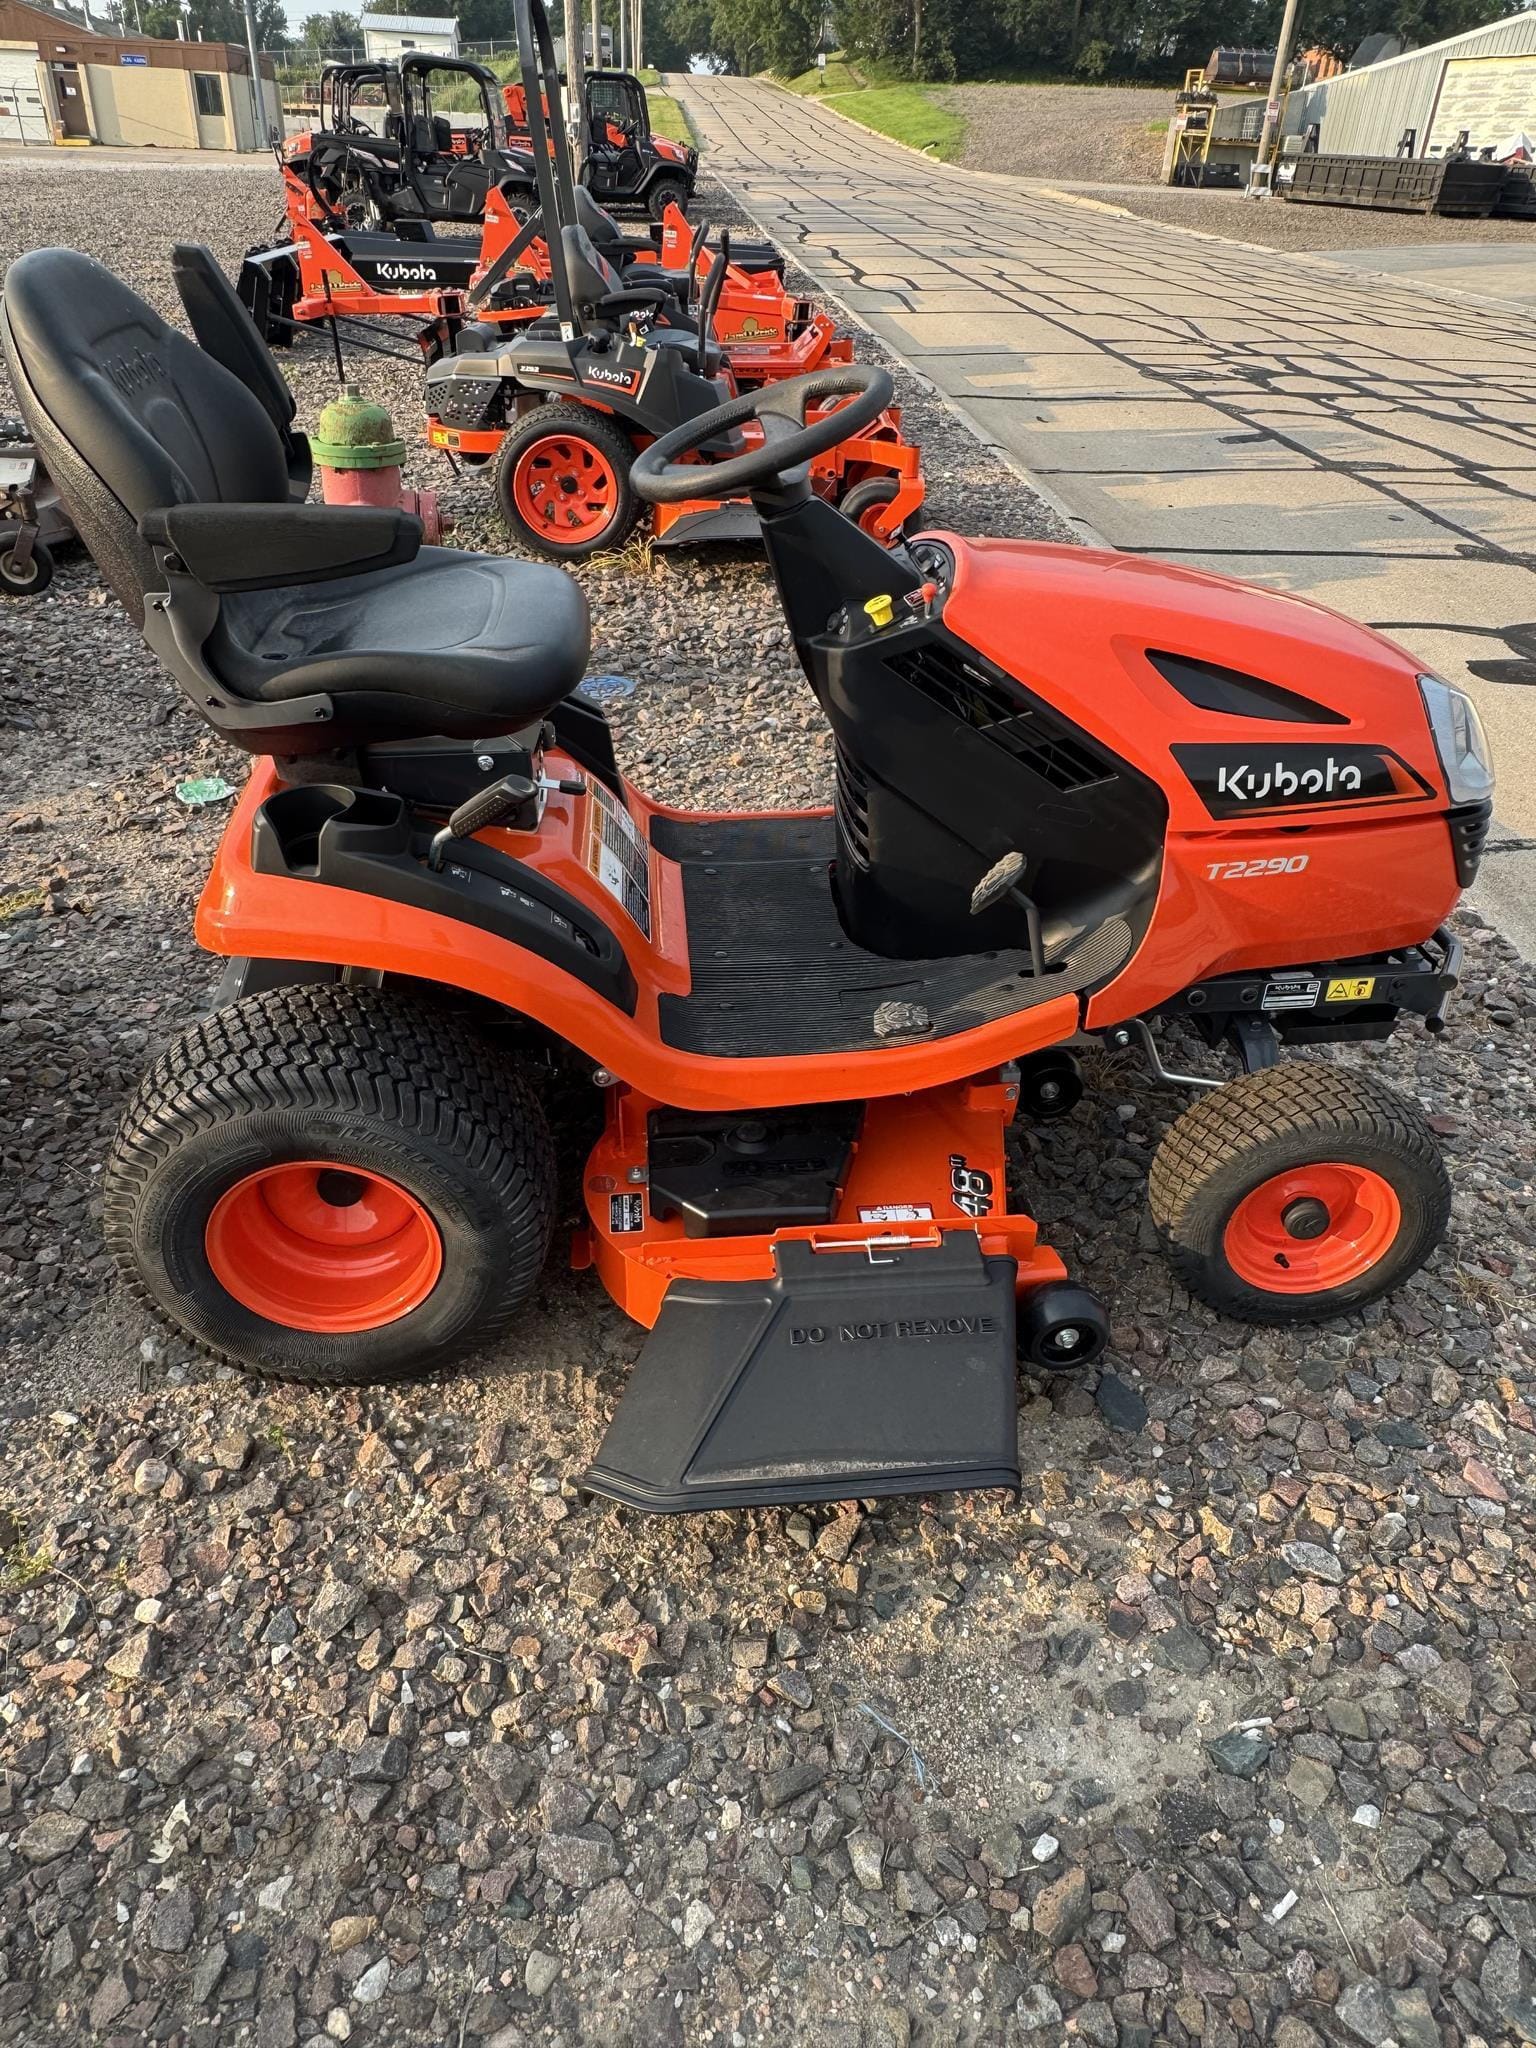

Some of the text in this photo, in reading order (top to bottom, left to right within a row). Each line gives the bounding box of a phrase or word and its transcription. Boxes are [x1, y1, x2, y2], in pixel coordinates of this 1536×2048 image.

[376, 262, 437, 280] Kubota
[102, 345, 167, 397] Kubota
[588, 365, 632, 386] Kubota
[1217, 757, 1362, 801] Kubota
[1206, 854, 1310, 881] T2290
[949, 1153, 994, 1218] 48"
[789, 1316, 997, 1345] DO NOT REMOVE
